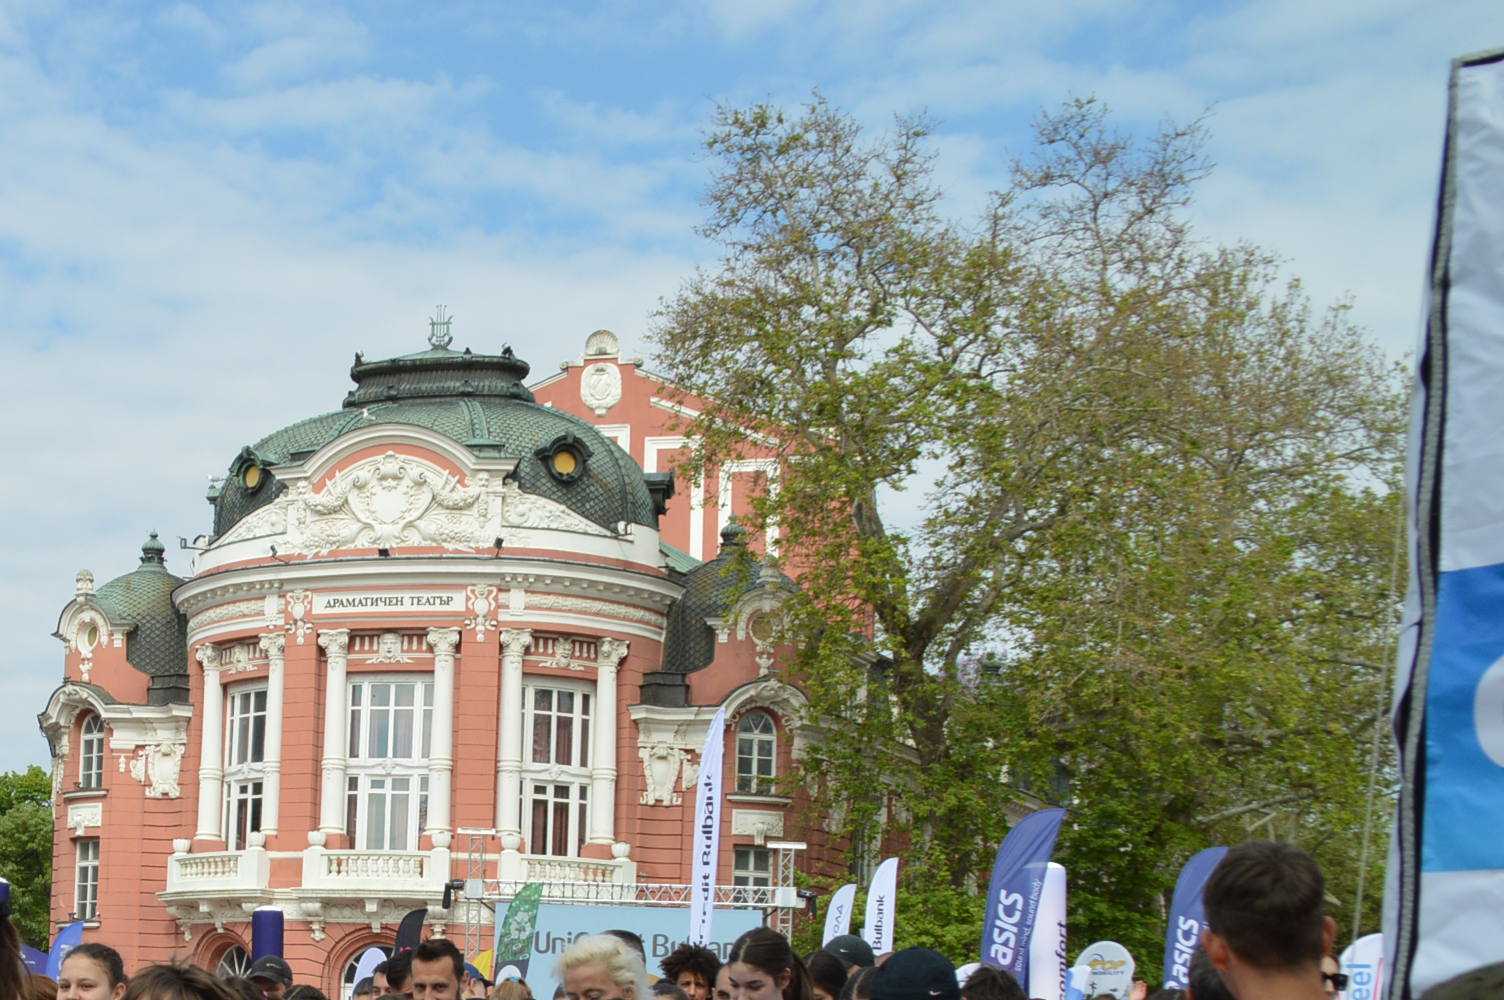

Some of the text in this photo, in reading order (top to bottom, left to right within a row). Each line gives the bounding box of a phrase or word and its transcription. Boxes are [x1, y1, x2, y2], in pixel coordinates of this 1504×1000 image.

[324, 595, 454, 609] ДРАМАТИЧЕН ТЕАТЪР
[872, 895, 885, 950] Bulbank
